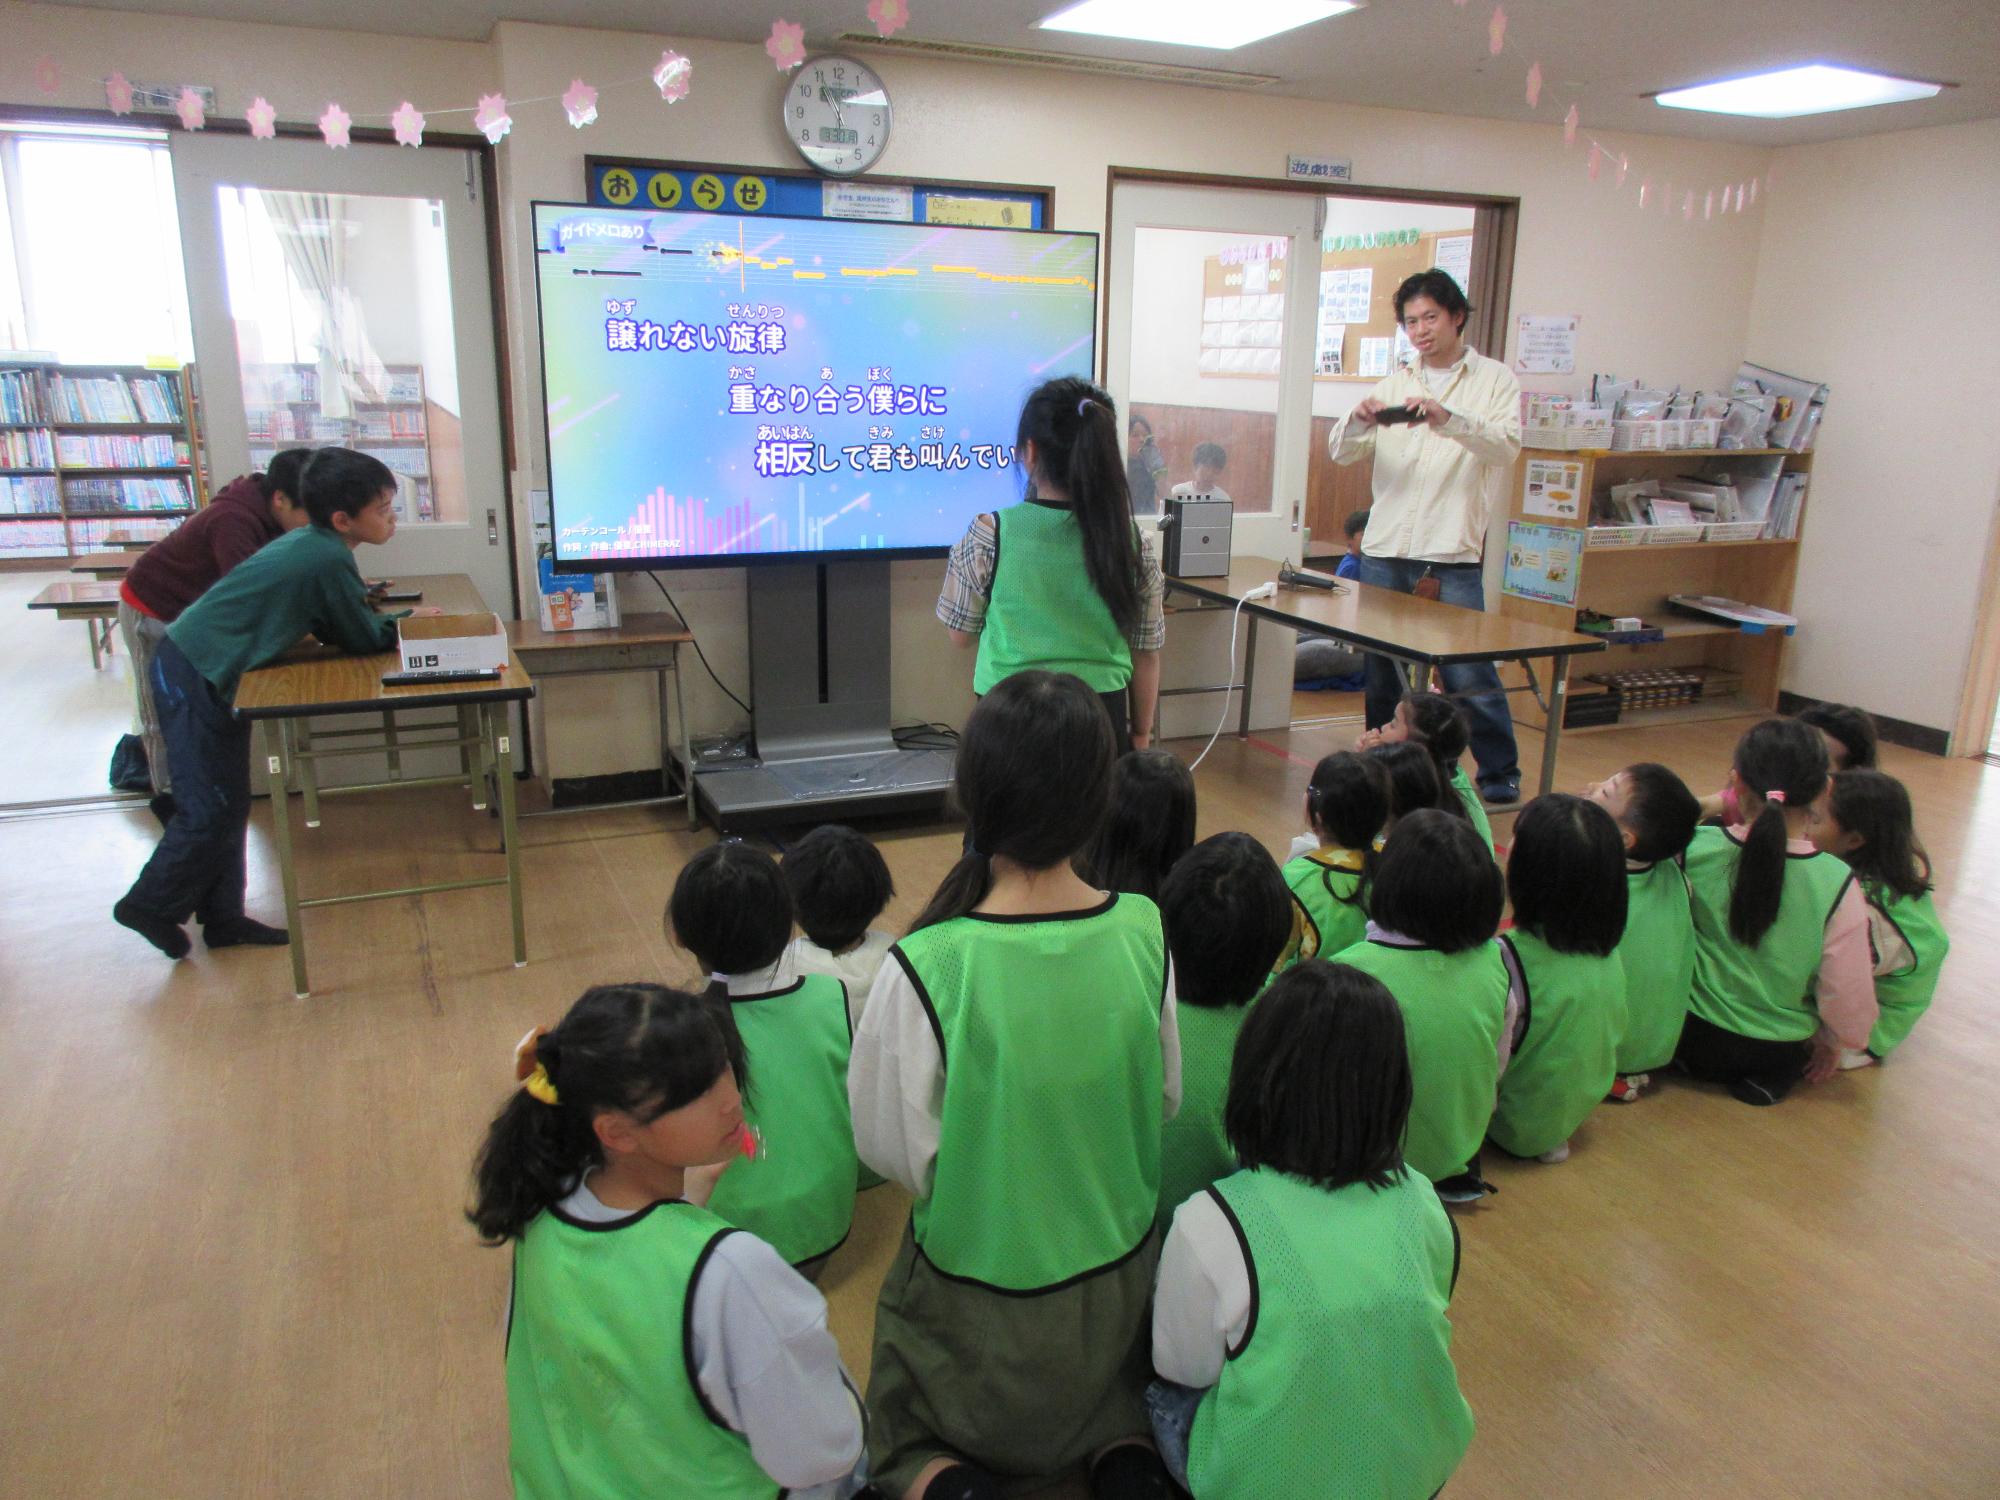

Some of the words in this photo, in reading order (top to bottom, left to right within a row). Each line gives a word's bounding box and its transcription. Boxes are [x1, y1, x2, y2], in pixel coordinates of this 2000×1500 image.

[815, 70, 824, 82] 11
[833, 67, 845, 80] 12
[800, 85, 811, 98] 10
[796, 106, 804, 119] 9
[873, 114, 881, 126] 3
[802, 129, 810, 141] 8
[867, 134, 875, 147] 4
[855, 148, 862, 160] 5
[608, 174, 761, 206] おしらせ
[561, 223, 644, 241] ガイドメロあり
[606, 299, 637, 315] ゆず
[727, 303, 785, 319] せんりつ
[606, 318, 786, 354] 譲れない旋律
[728, 366, 756, 381] かさ
[820, 366, 834, 381] あ
[867, 367, 892, 381] ぼく
[728, 383, 947, 415] 重なり合う僕らに
[756, 424, 814, 441] あいはん
[868, 425, 894, 440] きみ
[920, 425, 945, 440] さけ
[755, 441, 1017, 477] 相反して君も叫んでい
[562, 526, 626, 537] カーテンコール
